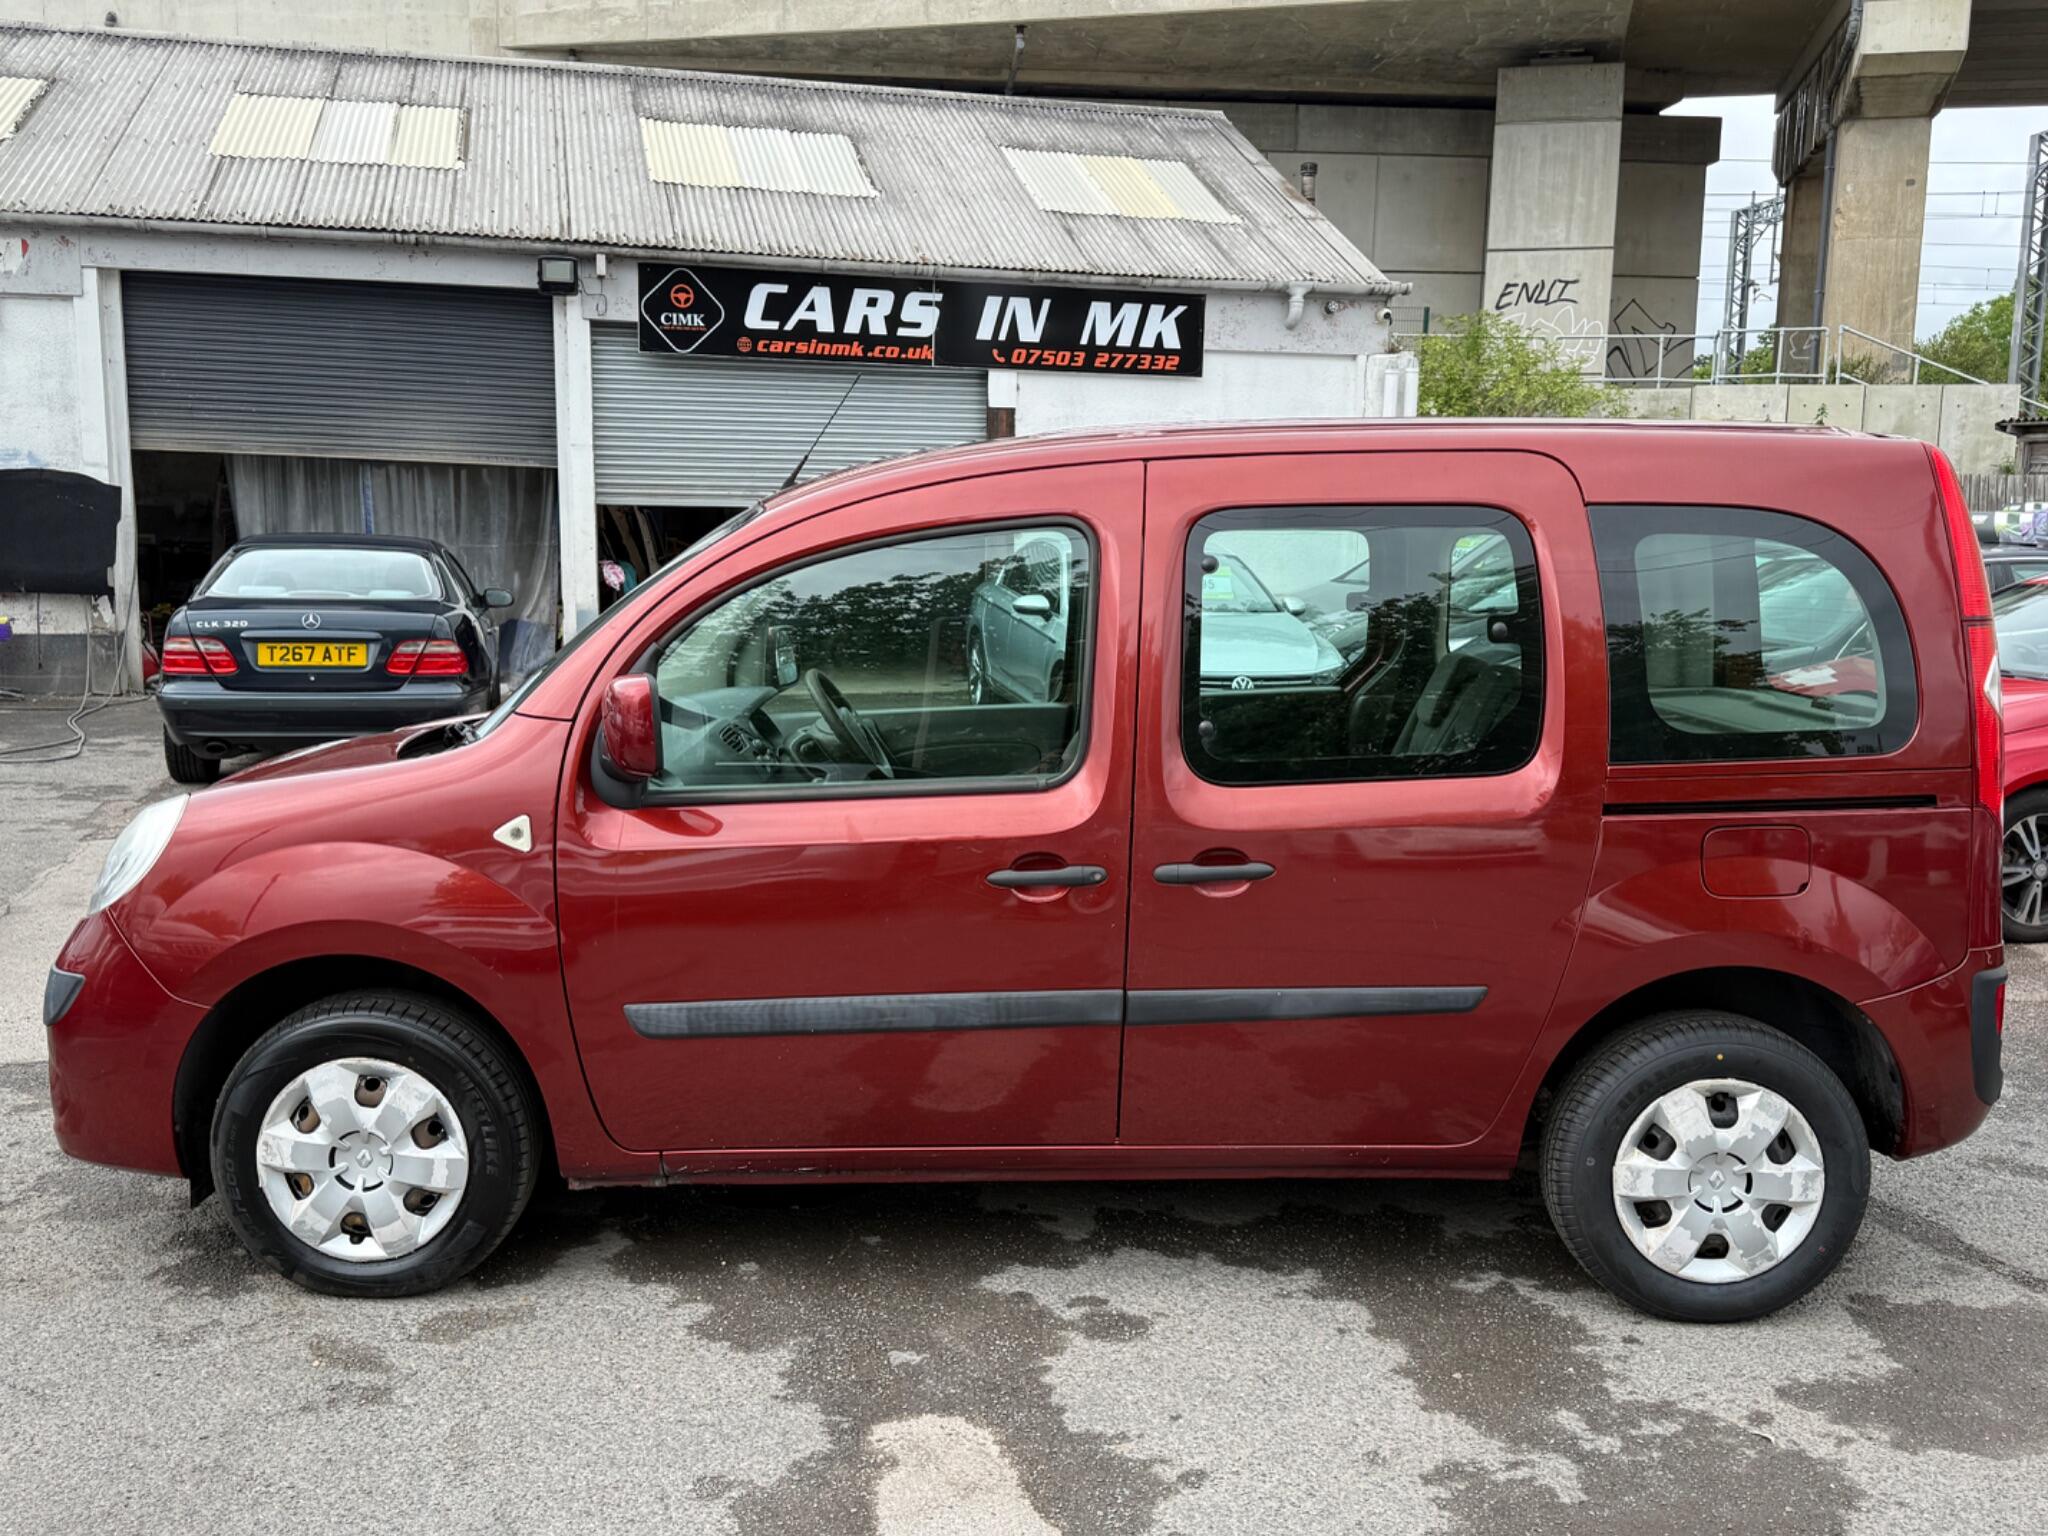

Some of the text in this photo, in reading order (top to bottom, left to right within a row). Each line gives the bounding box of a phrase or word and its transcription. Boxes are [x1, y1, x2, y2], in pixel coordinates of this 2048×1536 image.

[660, 312, 705, 326] CIMK
[744, 282, 1188, 349] CARS IN MK
[1011, 348, 1180, 371] 07503 277332
[196, 620, 248, 628] CLK 320
[266, 646, 358, 662] T267 ATF
